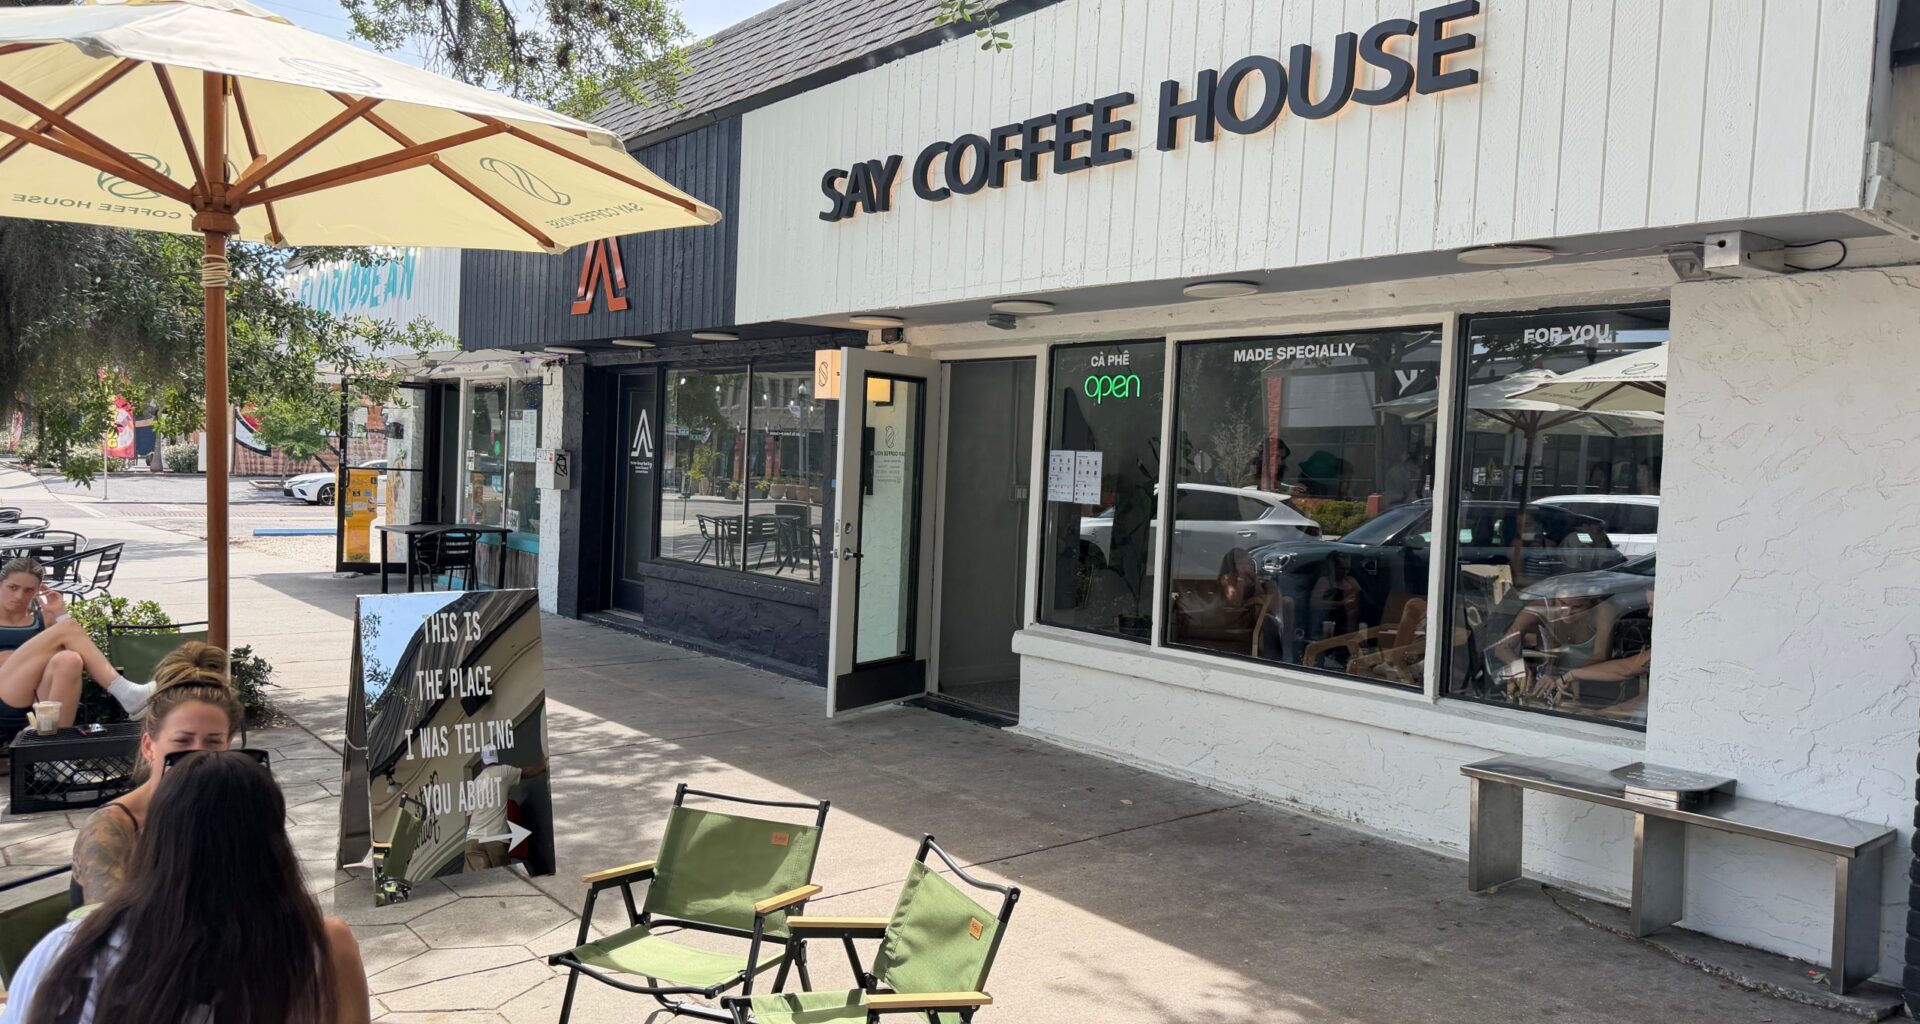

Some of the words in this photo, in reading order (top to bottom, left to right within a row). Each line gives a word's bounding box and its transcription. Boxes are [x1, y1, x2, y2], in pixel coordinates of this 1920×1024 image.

[819, 154, 903, 222] SAY
[912, 92, 1135, 202] COFFEE
[1156, 0, 1481, 152] HOUSE
[1523, 326, 1563, 344] FOR
[1567, 323, 1610, 341] YOU
[1090, 351, 1106, 367] CÀ
[1107, 350, 1130, 366] PHÊ
[1233, 348, 1274, 363] MADE
[1276, 343, 1356, 360] SPECIALLY
[1084, 374, 1141, 405] open
[422, 612, 458, 644] THIS
[463, 610, 482, 642] IS
[416, 668, 444, 701] THE
[450, 665, 493, 699] PLACE
[405, 729, 415, 761] I
[419, 725, 449, 759] WAS
[455, 718, 515, 755] TELLING
[422, 782, 451, 817] YOU
[458, 776, 502, 813] ABOUT
